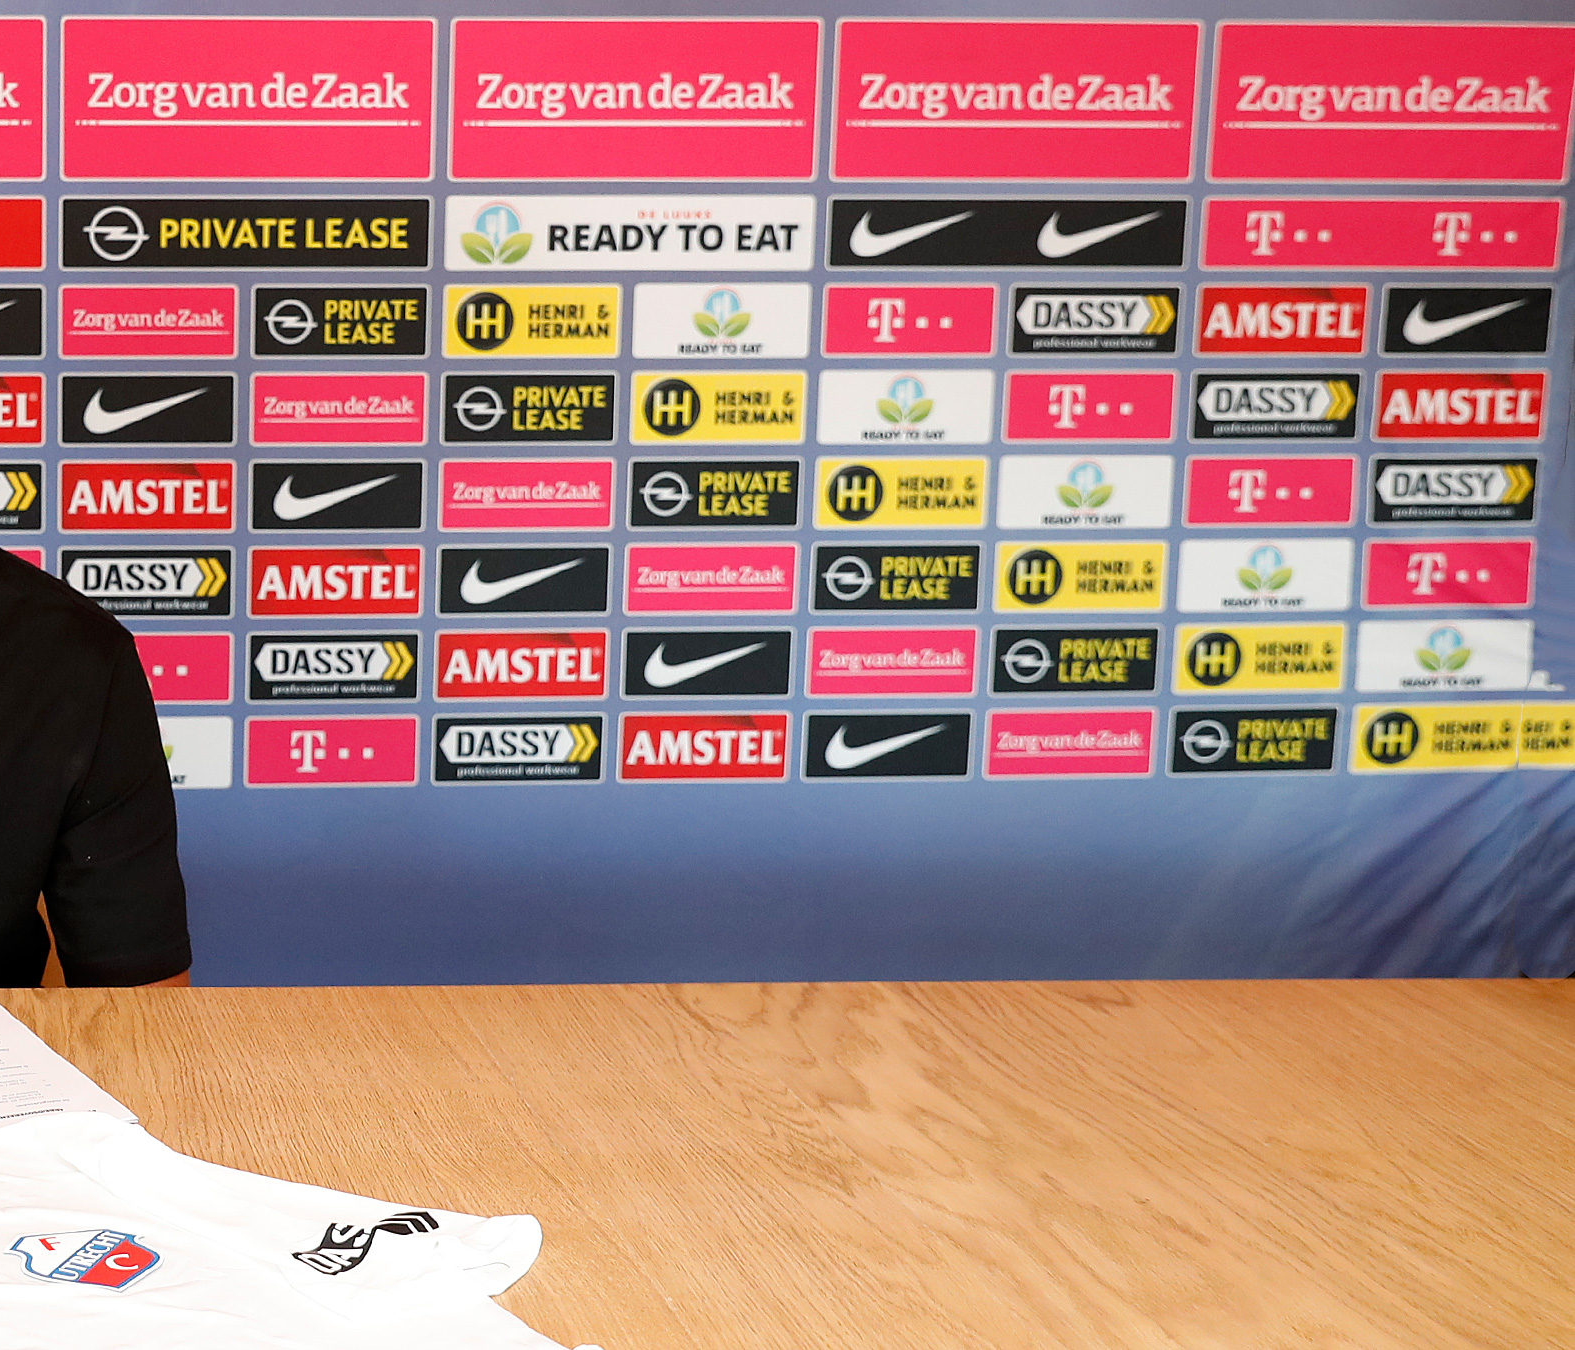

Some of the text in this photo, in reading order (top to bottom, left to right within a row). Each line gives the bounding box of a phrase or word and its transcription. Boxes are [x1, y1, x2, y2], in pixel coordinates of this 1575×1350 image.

[87, 73, 409, 117] Zorg van de Zaak
[476, 73, 794, 118] Zorg van de Zaak
[858, 74, 1173, 118] Zorg van de Zaak
[1236, 77, 1552, 120] Zorg van de Zaak
[159, 218, 409, 249] PRIVATE LEASE
[547, 224, 798, 251] READY TO EAT
[74, 308, 224, 331] Zorg van de Zaak
[324, 299, 419, 321] PRIVATE
[529, 305, 610, 320] HENRI &
[1032, 301, 1137, 328] DASSY
[323, 323, 396, 344] LEASE
[529, 323, 609, 339] HERMAN
[265, 396, 414, 418] Zorg van de Zaak
[513, 386, 607, 407] PRIVATE
[1213, 387, 1318, 414] DASSY
[512, 410, 584, 430] LEASE
[453, 481, 601, 504] Zorg van de Zaak
[698, 472, 792, 493] PRIVATE
[1392, 472, 1495, 498] DASSY
[697, 495, 769, 515] LEASE
[83, 564, 188, 590] DASSY
[880, 556, 972, 577] PRIVATE
[879, 579, 950, 599] LEASE
[1059, 639, 1151, 659] PRIVATE
[271, 648, 375, 675] DASSY
[1058, 662, 1128, 681] LEASE
[456, 731, 560, 757] DASSY
[51, 1231, 127, 1282] UTRECHT
[105, 1253, 139, 1271] C
